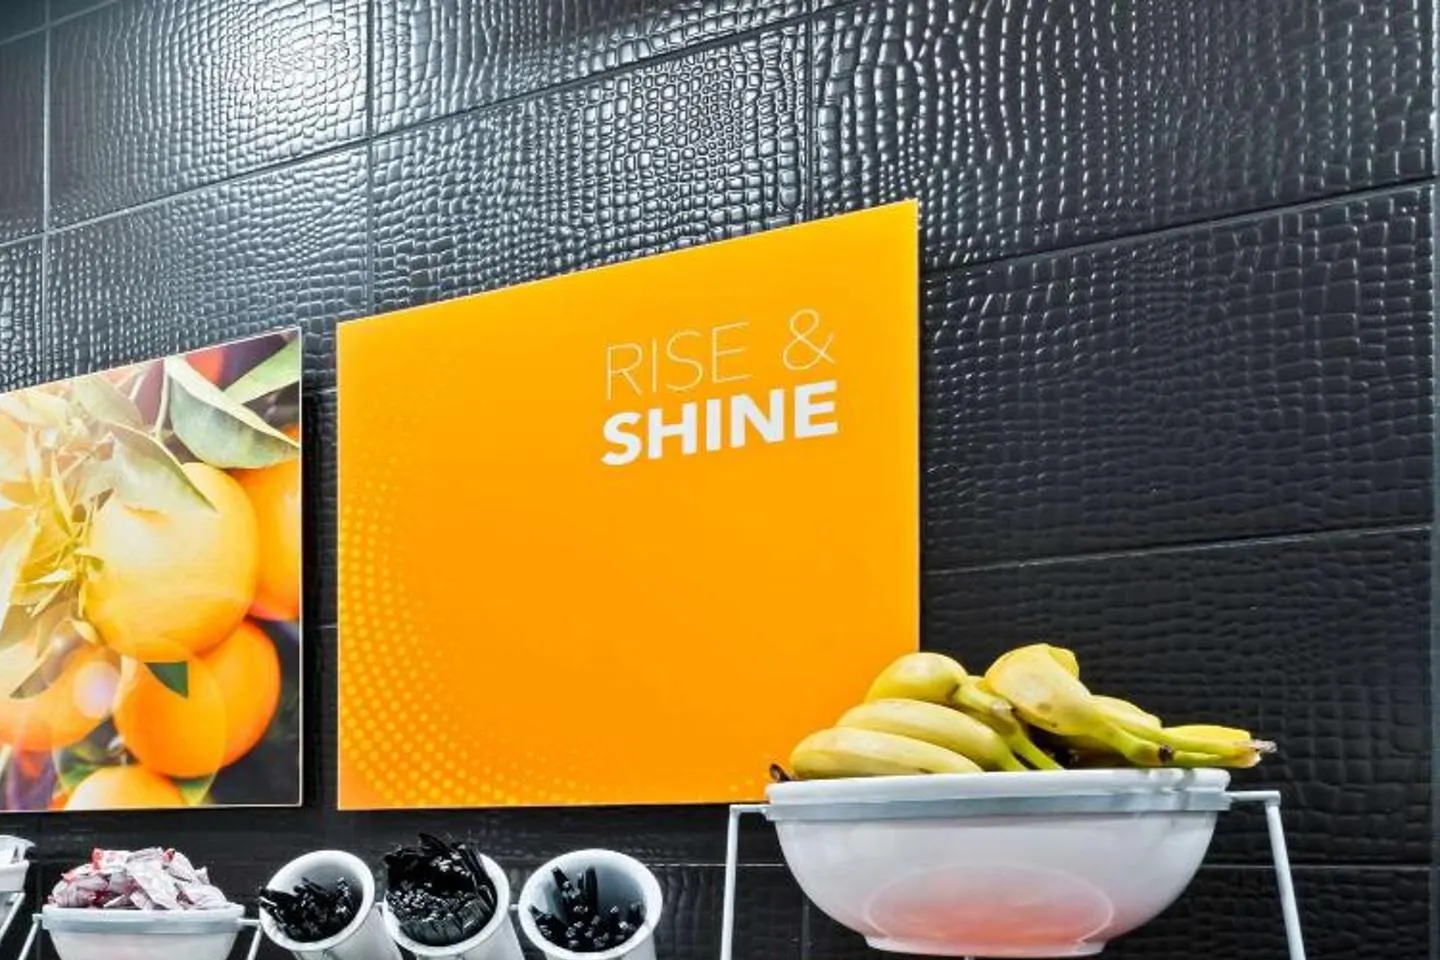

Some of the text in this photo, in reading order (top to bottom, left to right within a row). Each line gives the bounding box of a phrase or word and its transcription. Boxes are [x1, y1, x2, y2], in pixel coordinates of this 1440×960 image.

[606, 308, 835, 400] RISE &
[601, 380, 839, 466] SHINE
